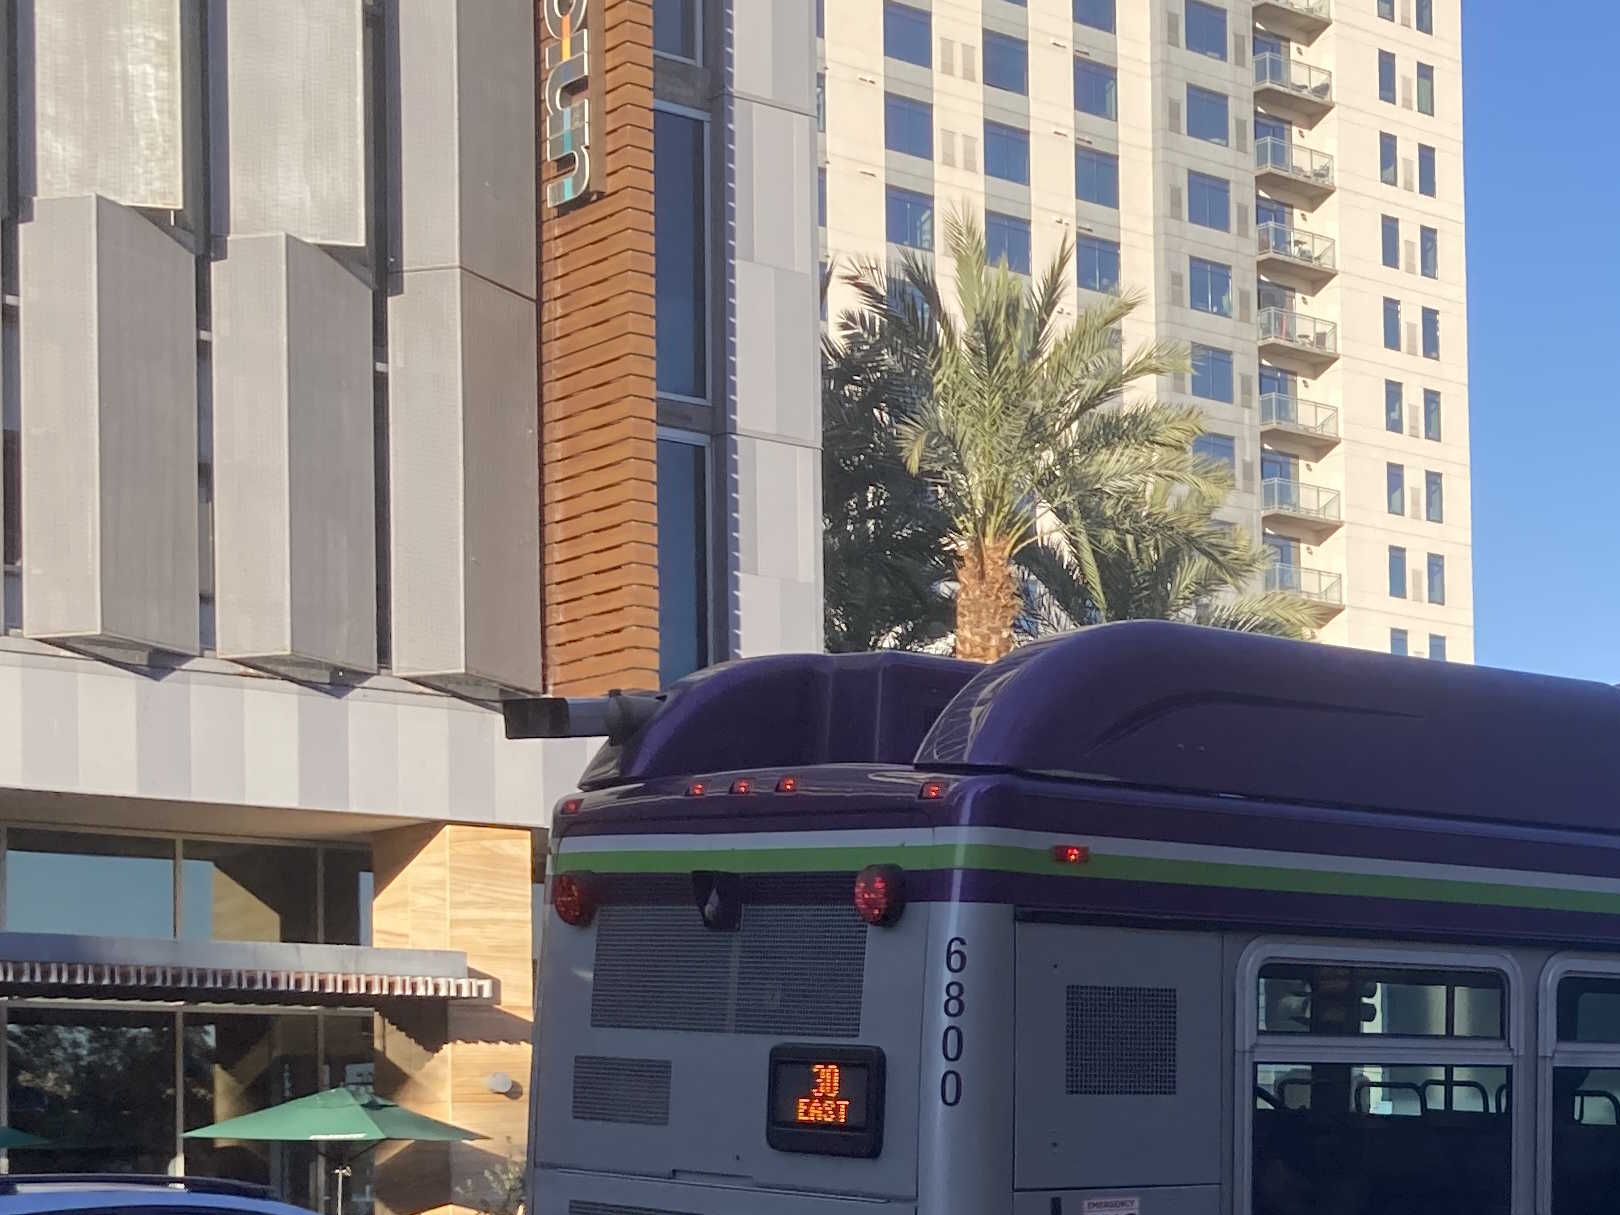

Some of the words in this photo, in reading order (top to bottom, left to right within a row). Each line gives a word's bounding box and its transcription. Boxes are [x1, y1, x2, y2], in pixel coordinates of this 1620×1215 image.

[941, 937, 967, 1106] 6800
[811, 1063, 840, 1097] 30
[797, 1098, 849, 1123] EAST
